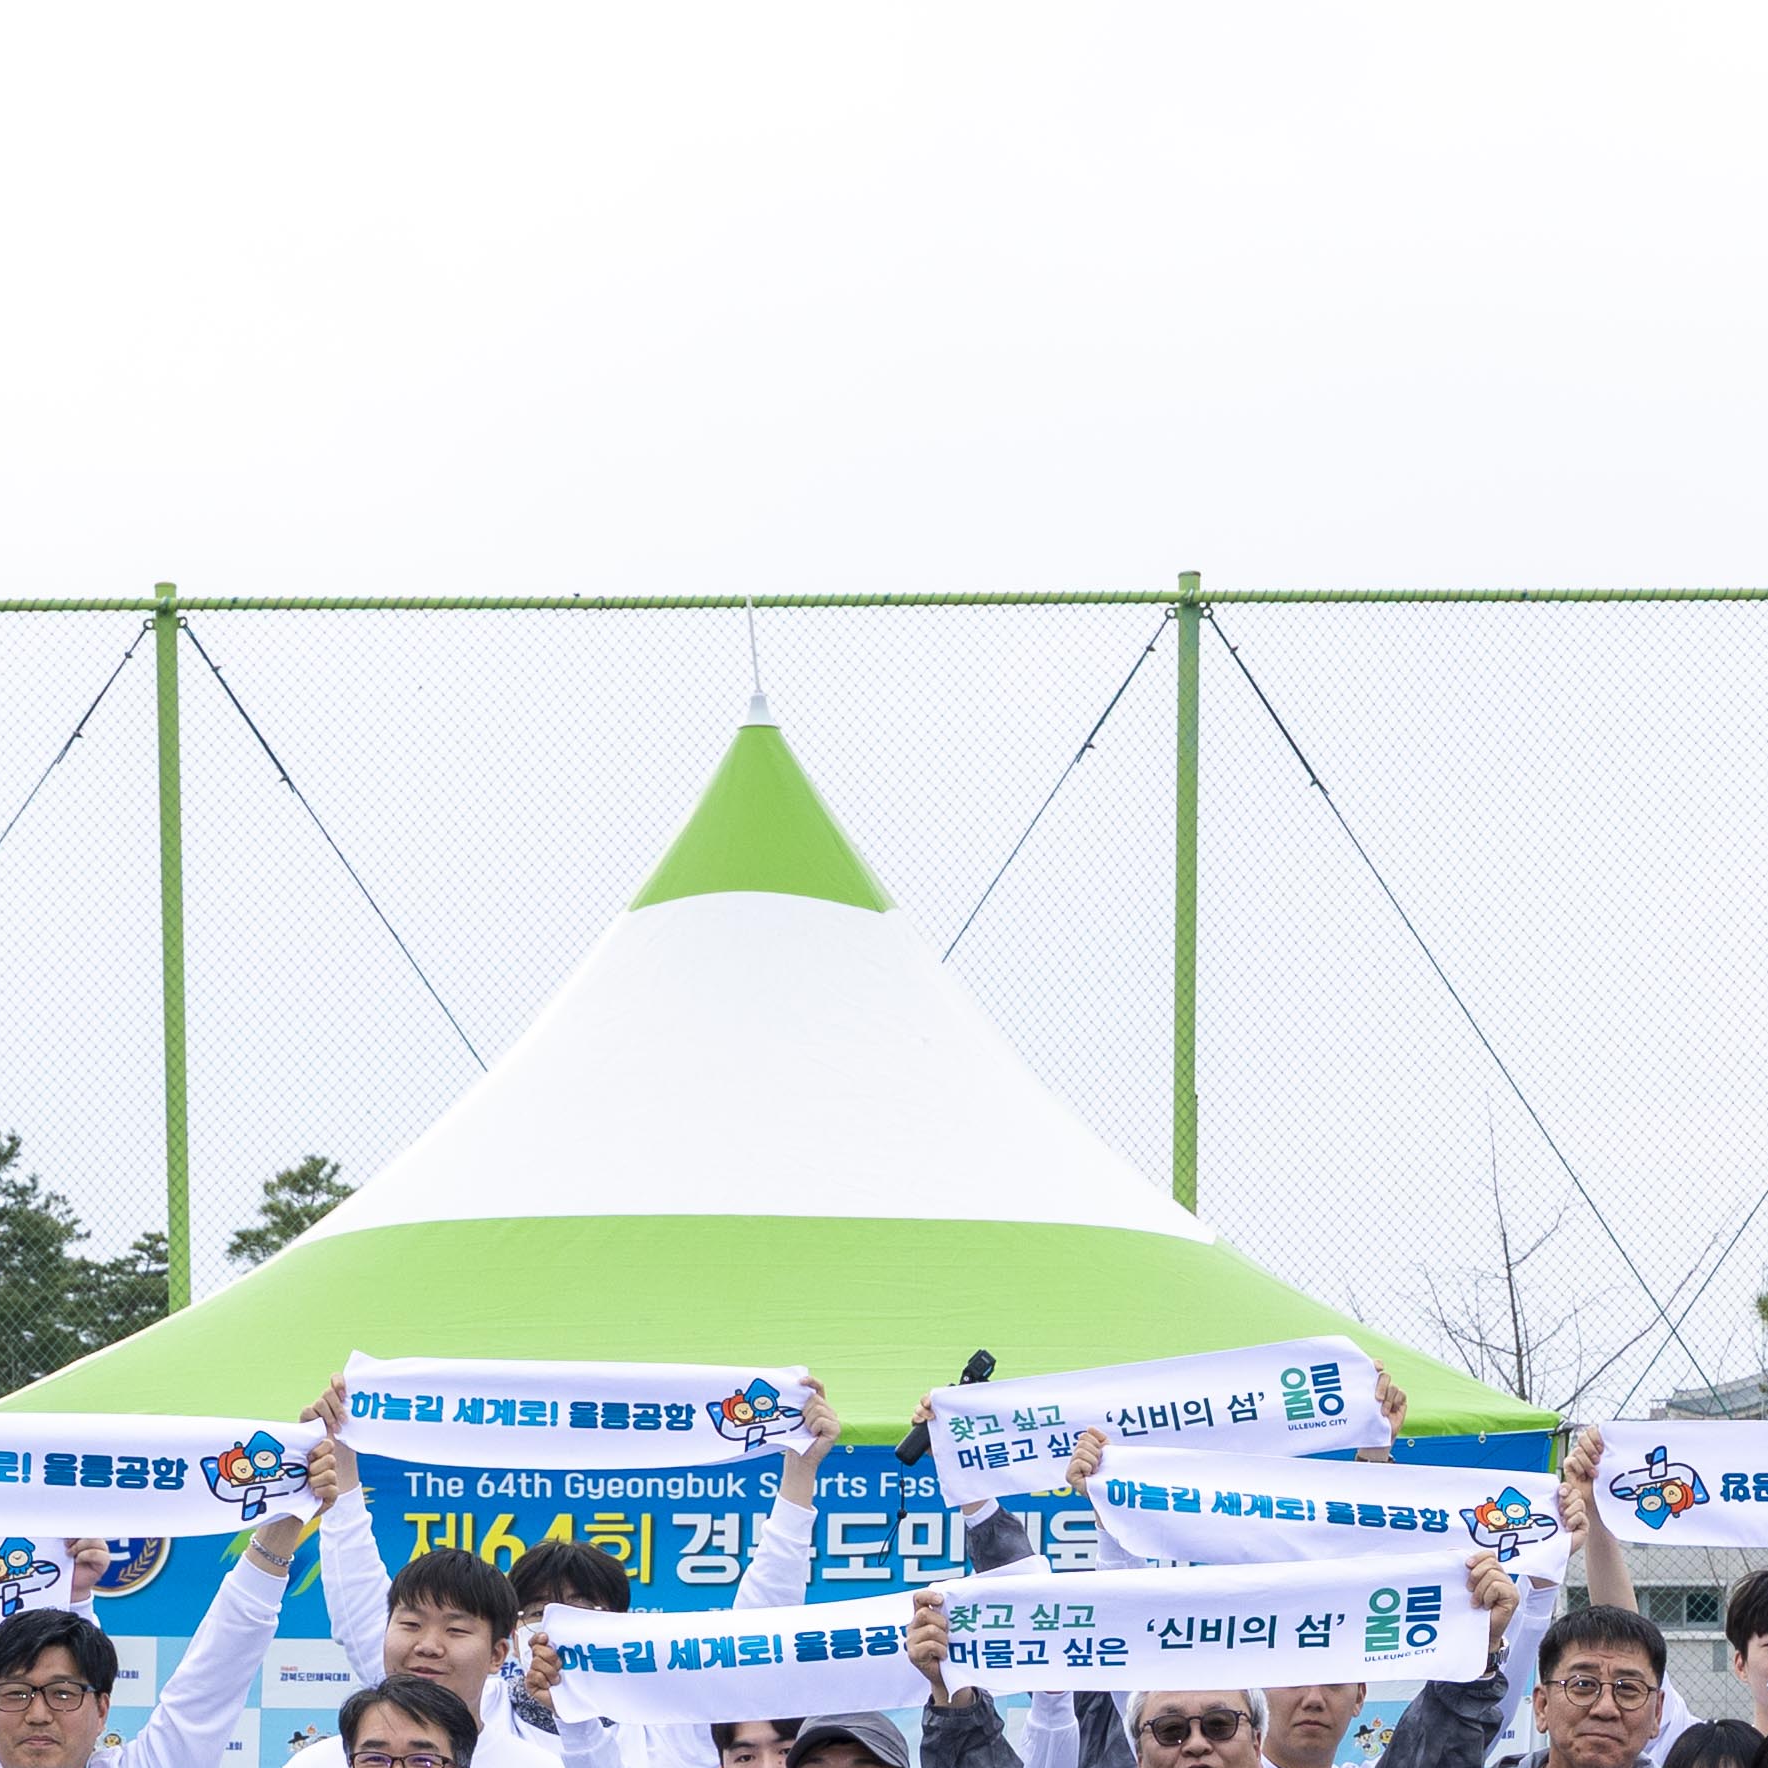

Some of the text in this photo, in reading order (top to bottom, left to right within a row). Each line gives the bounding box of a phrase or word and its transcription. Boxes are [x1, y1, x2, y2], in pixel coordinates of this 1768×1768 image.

[351, 1392, 697, 1433] 하늘길 세계로! 울릉공항
[1281, 1363, 1346, 1423] 울릉
[950, 1406, 1067, 1447] 찾고 싶고
[1285, 1416, 1350, 1434] ULLEUNG CITY
[44, 1453, 190, 1492] 울릉공항
[956, 1436, 1040, 1472] 머물고
[404, 1471, 464, 1498] The
[476, 1471, 552, 1498] 64th
[564, 1472, 747, 1506] Gyeongbuk
[759, 1471, 867, 1498] Srts
[1106, 1479, 1203, 1515] 하늘길
[1326, 1502, 1451, 1535] 울릉공항
[950, 1604, 1097, 1634] 찾고 싶고
[1366, 1585, 1443, 1653] 울릉
[667, 1635, 785, 1672] 세계로!
[795, 1626, 908, 1664] 울릉공
[949, 1638, 1130, 1670] 머물고 싶은
[1362, 1646, 1438, 1663] ULLEUNG CITY
